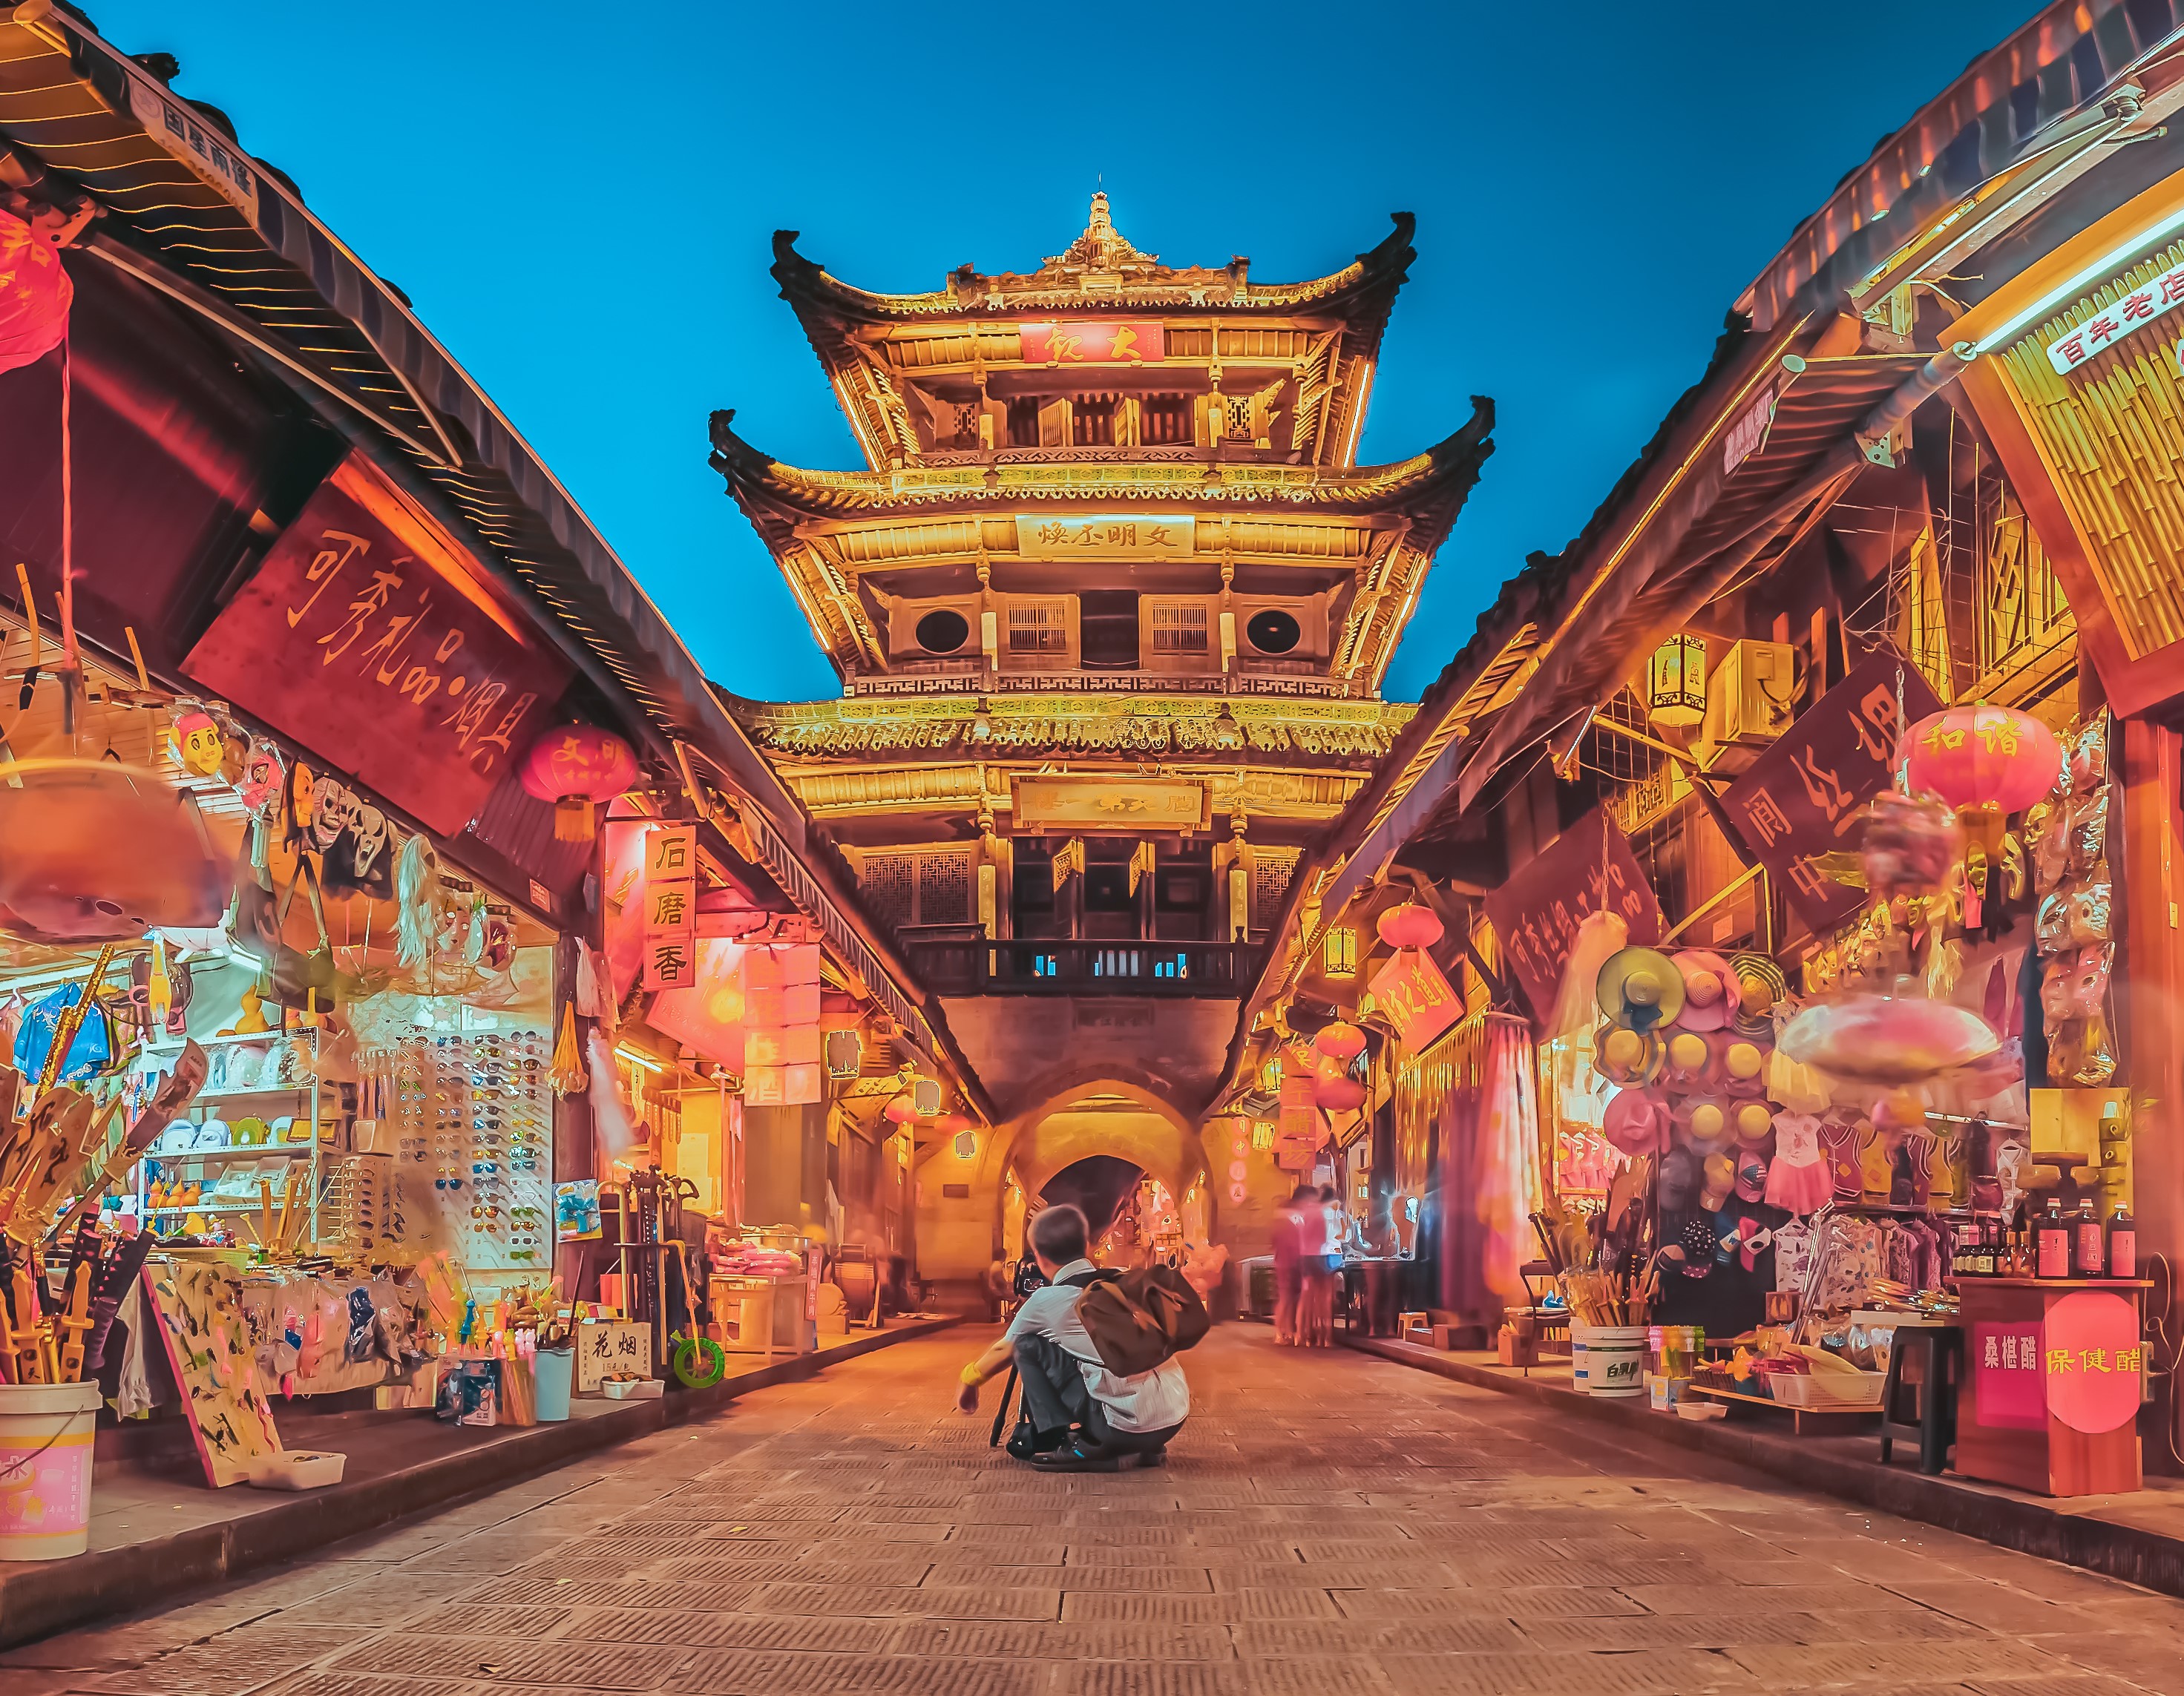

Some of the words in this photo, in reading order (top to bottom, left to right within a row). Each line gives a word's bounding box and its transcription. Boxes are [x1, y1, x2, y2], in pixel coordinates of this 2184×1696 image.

[2056, 271, 2184, 365] 百年老店
[1921, 709, 2024, 757] 和谐
[653, 837, 688, 982] 石磨香
[591, 1329, 637, 1358] 花烟
[2045, 1347, 2140, 1375] 保健醋
